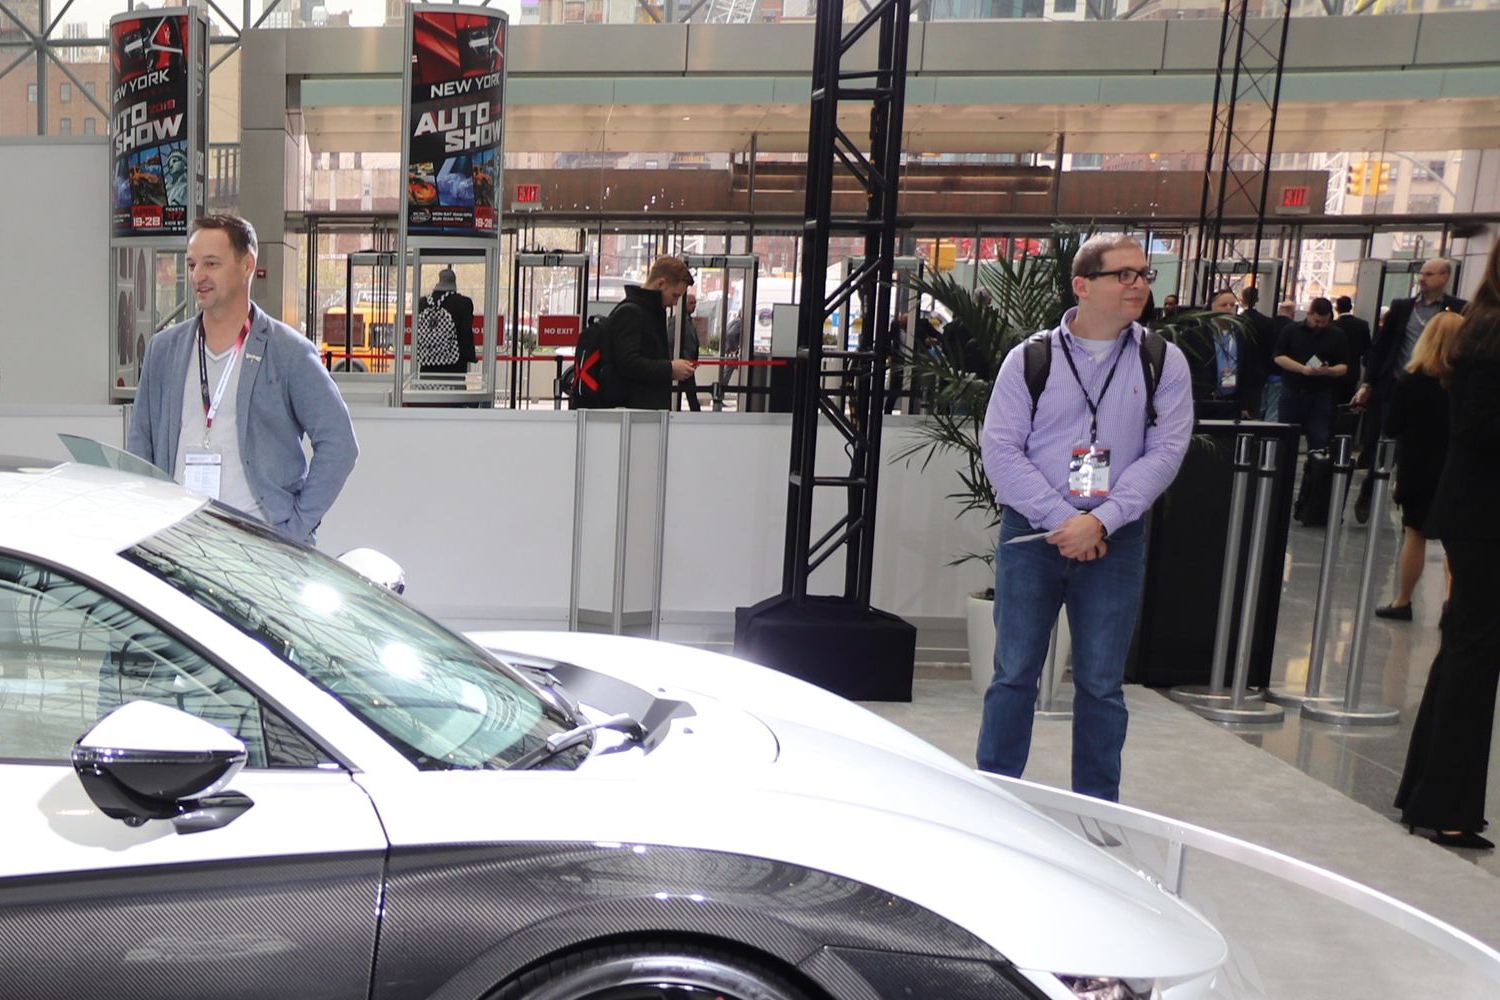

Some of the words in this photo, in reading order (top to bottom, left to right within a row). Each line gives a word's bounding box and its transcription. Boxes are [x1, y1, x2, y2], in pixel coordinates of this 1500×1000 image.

[129, 68, 170, 93] YORK
[430, 78, 472, 99] NEW
[475, 72, 500, 91] YORK
[113, 101, 147, 139] UTO
[413, 101, 490, 137] AUTO
[116, 113, 184, 157] SHOW
[445, 118, 502, 153] SHOW
[517, 185, 539, 202] EXIT
[1284, 188, 1307, 207] EXIT
[133, 216, 161, 227] 19-28
